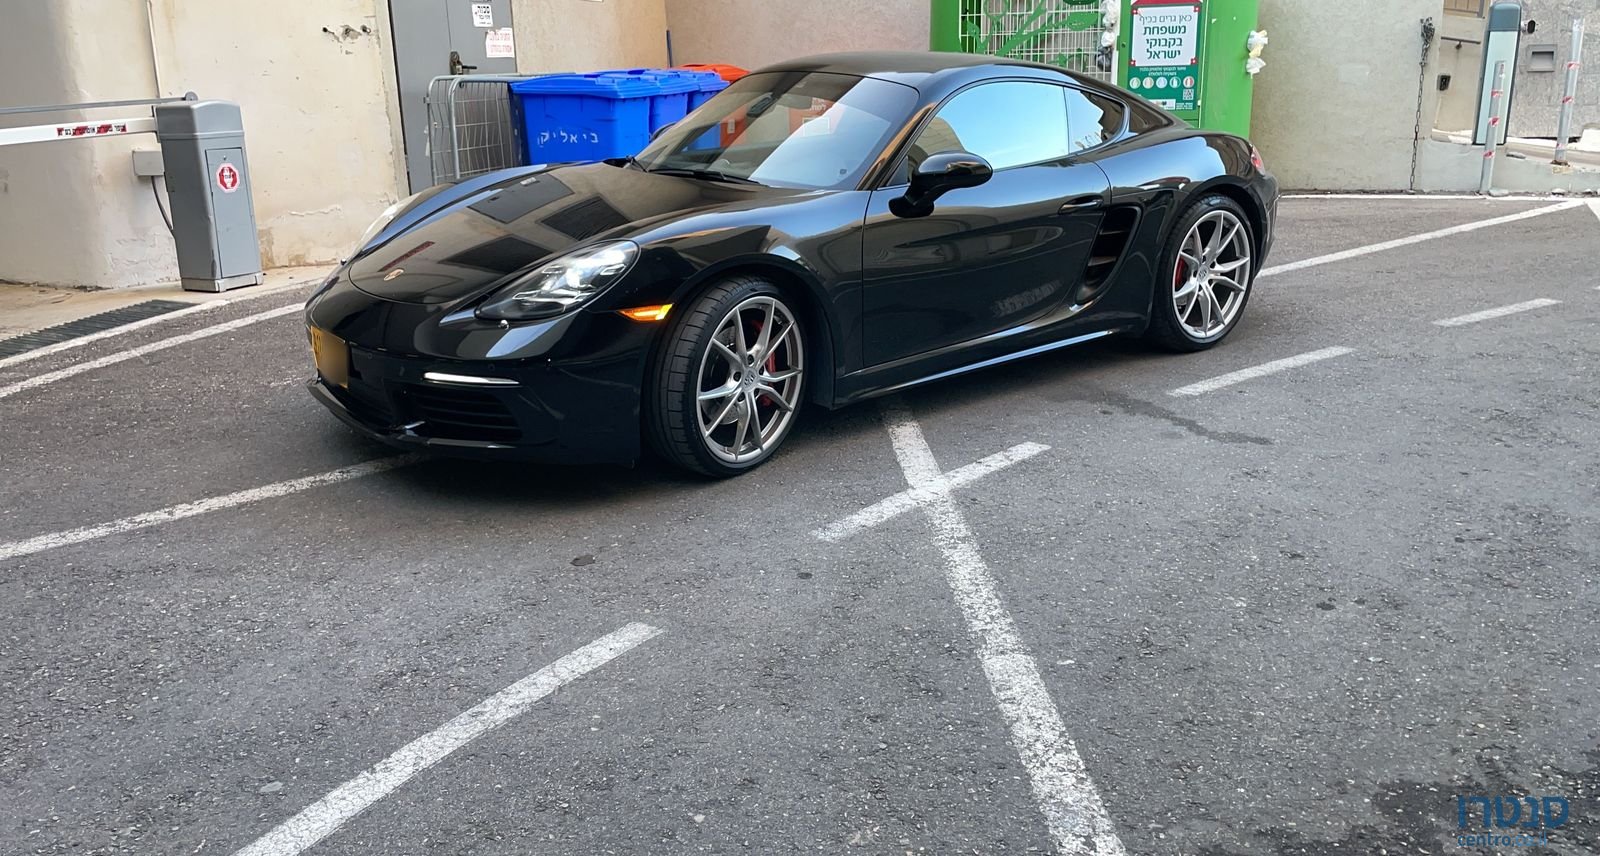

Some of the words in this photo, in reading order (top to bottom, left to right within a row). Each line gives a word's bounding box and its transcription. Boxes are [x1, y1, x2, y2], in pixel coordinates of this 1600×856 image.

[1139, 15, 1158, 25] בכיף
[1159, 15, 1177, 23] גרים
[1178, 14, 1193, 24] כאן
[1143, 25, 1187, 36] משפחת
[1146, 37, 1183, 49] בקבוקי
[1146, 48, 1181, 60] ישראל
